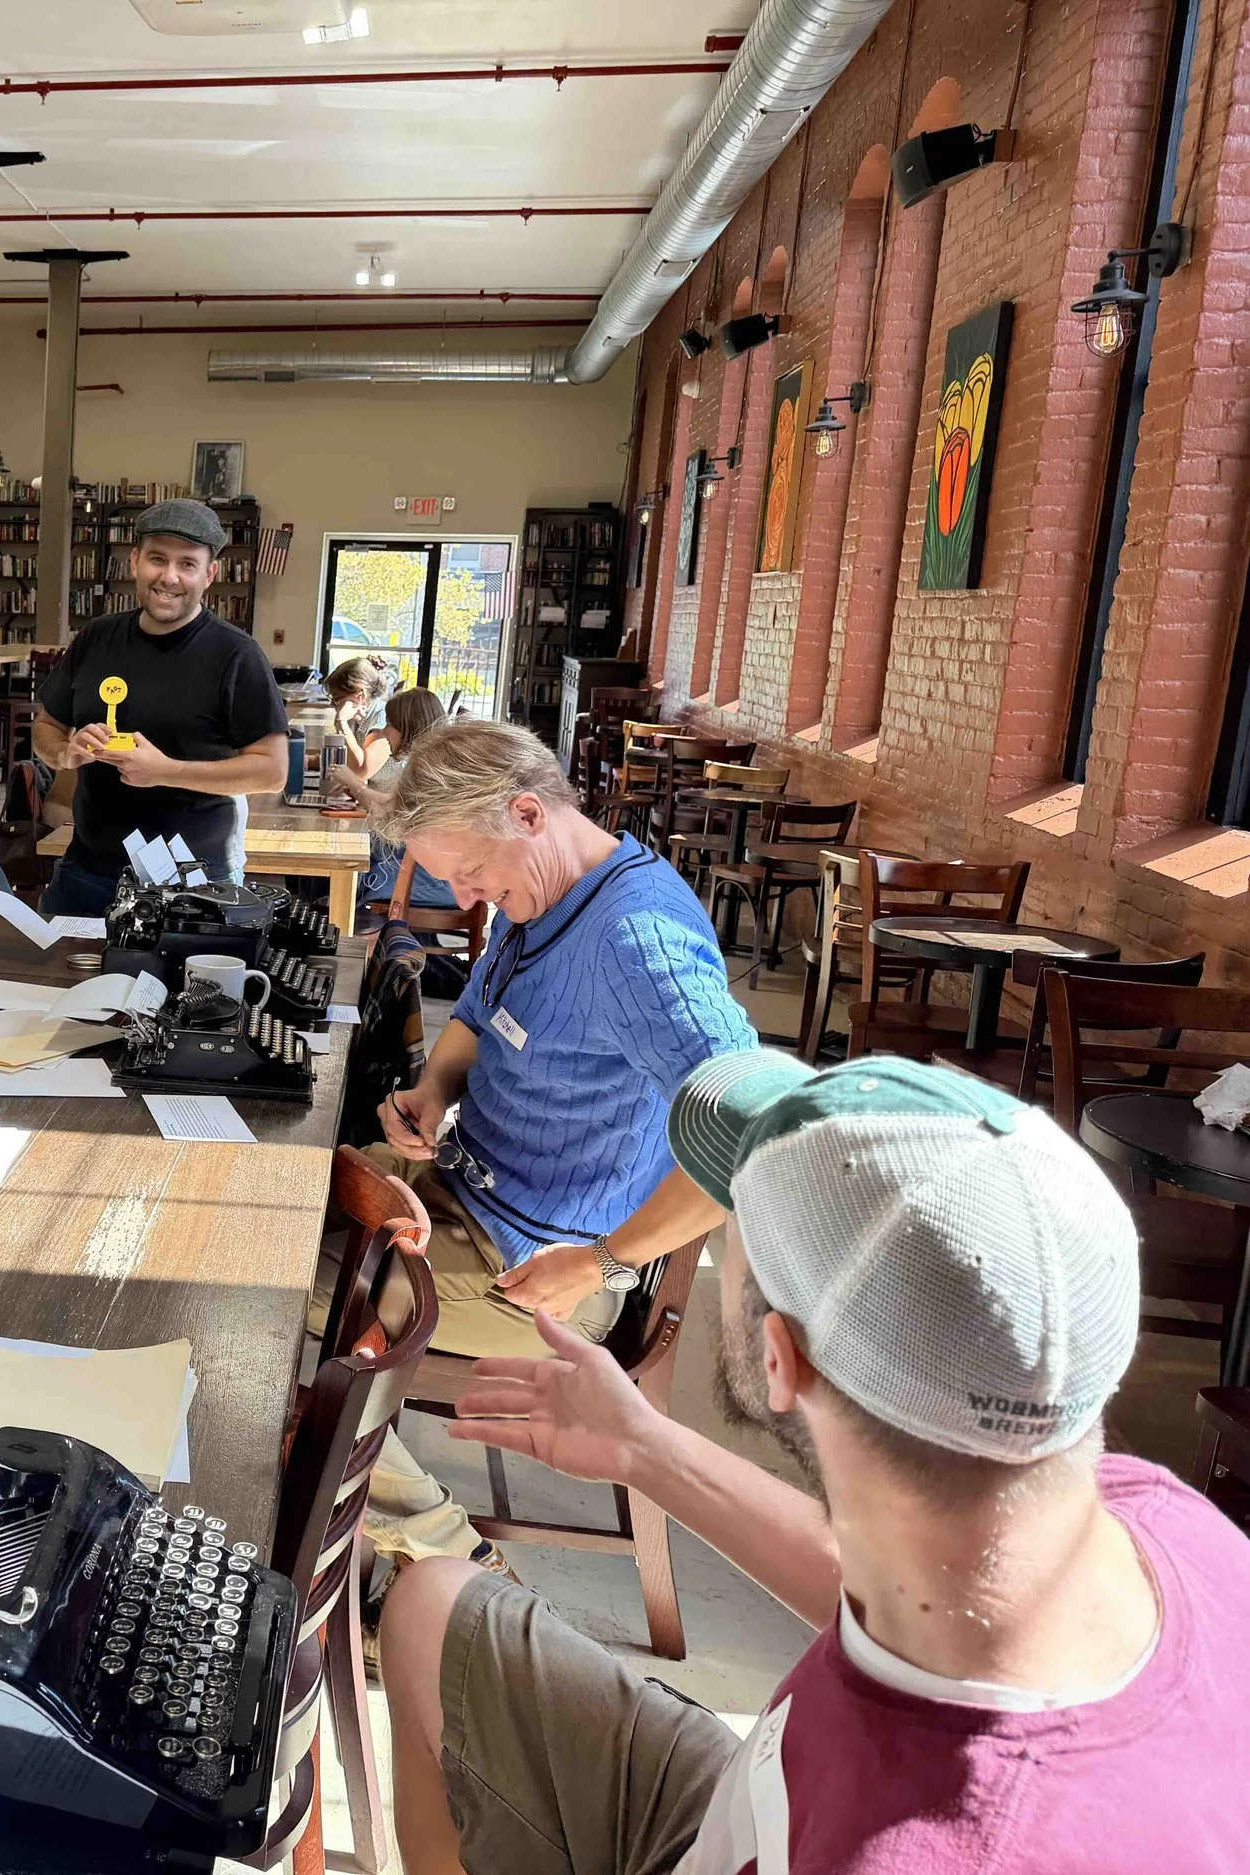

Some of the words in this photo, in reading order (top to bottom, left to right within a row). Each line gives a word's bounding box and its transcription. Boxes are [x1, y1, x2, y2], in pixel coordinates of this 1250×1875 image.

[413, 498, 437, 516] EXIT
[968, 1392, 1097, 1418] WORMT
[979, 1416, 1077, 1436] BREW
[83, 1543, 103, 1580] CORONA
